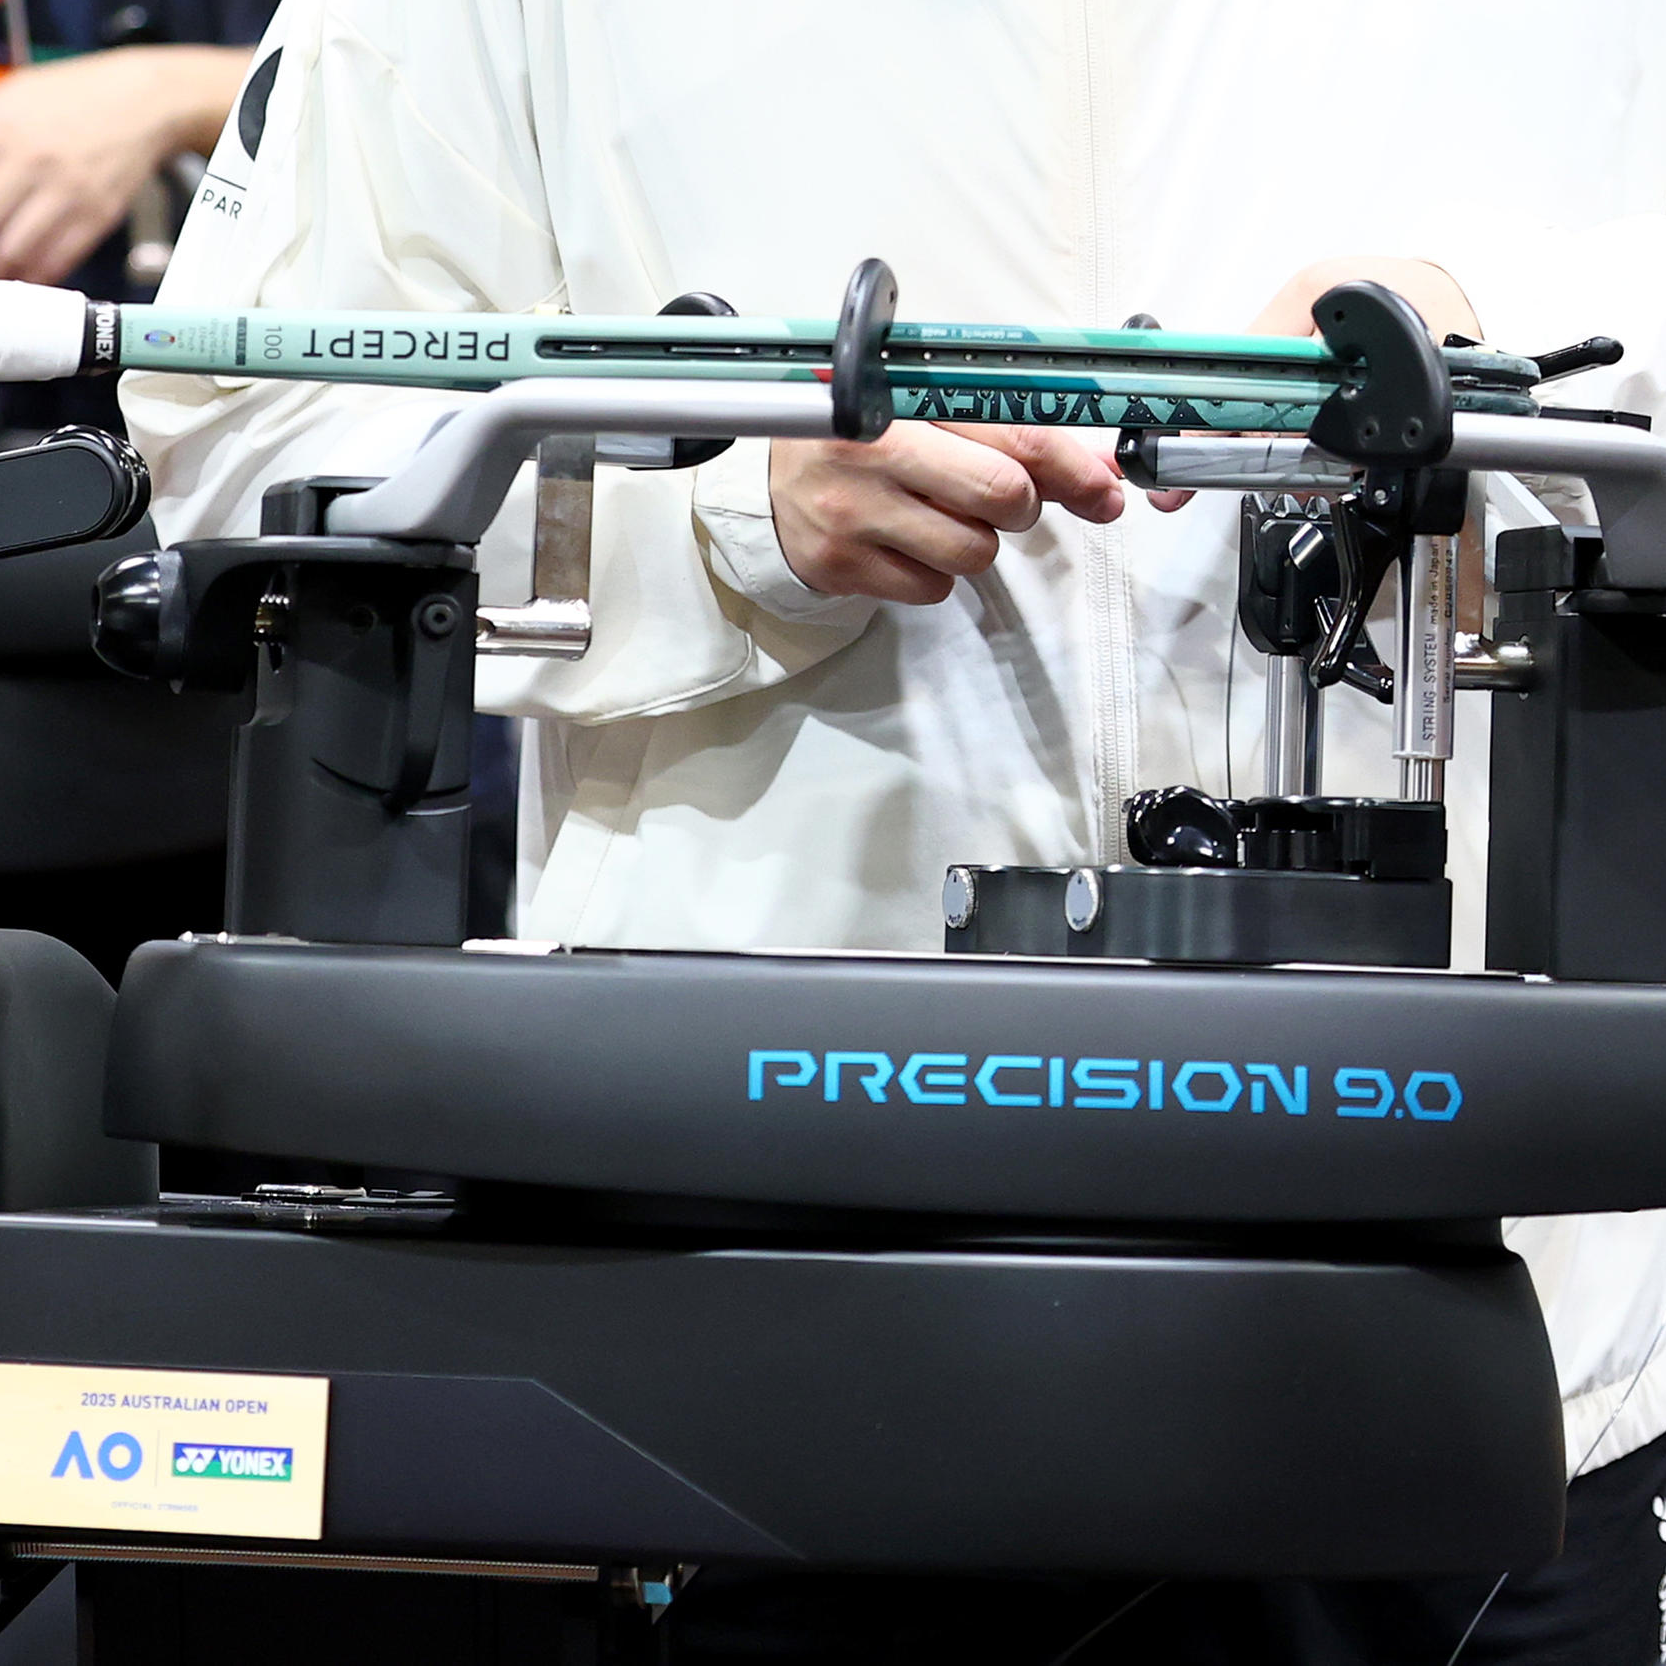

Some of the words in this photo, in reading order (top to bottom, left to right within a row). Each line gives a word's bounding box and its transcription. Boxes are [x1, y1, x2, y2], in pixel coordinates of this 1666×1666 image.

[95, 302, 116, 361] YONEX
[263, 325, 282, 360] 100
[302, 329, 510, 362] PERCEPT
[1429, 543, 1440, 577] Japan
[1429, 581, 1439, 592] in
[1428, 594, 1439, 625] made
[1423, 633, 1437, 683] SYSTEM
[1422, 691, 1437, 742] STRING
[747, 1048, 1308, 1116] PRECISION
[1333, 1065, 1463, 1122] 9.0
[81, 1392, 116, 1408] 2025
[121, 1395, 220, 1412] AUSTRALIAN
[226, 1399, 268, 1414] OPEN
[217, 1449, 287, 1478] YONEX
